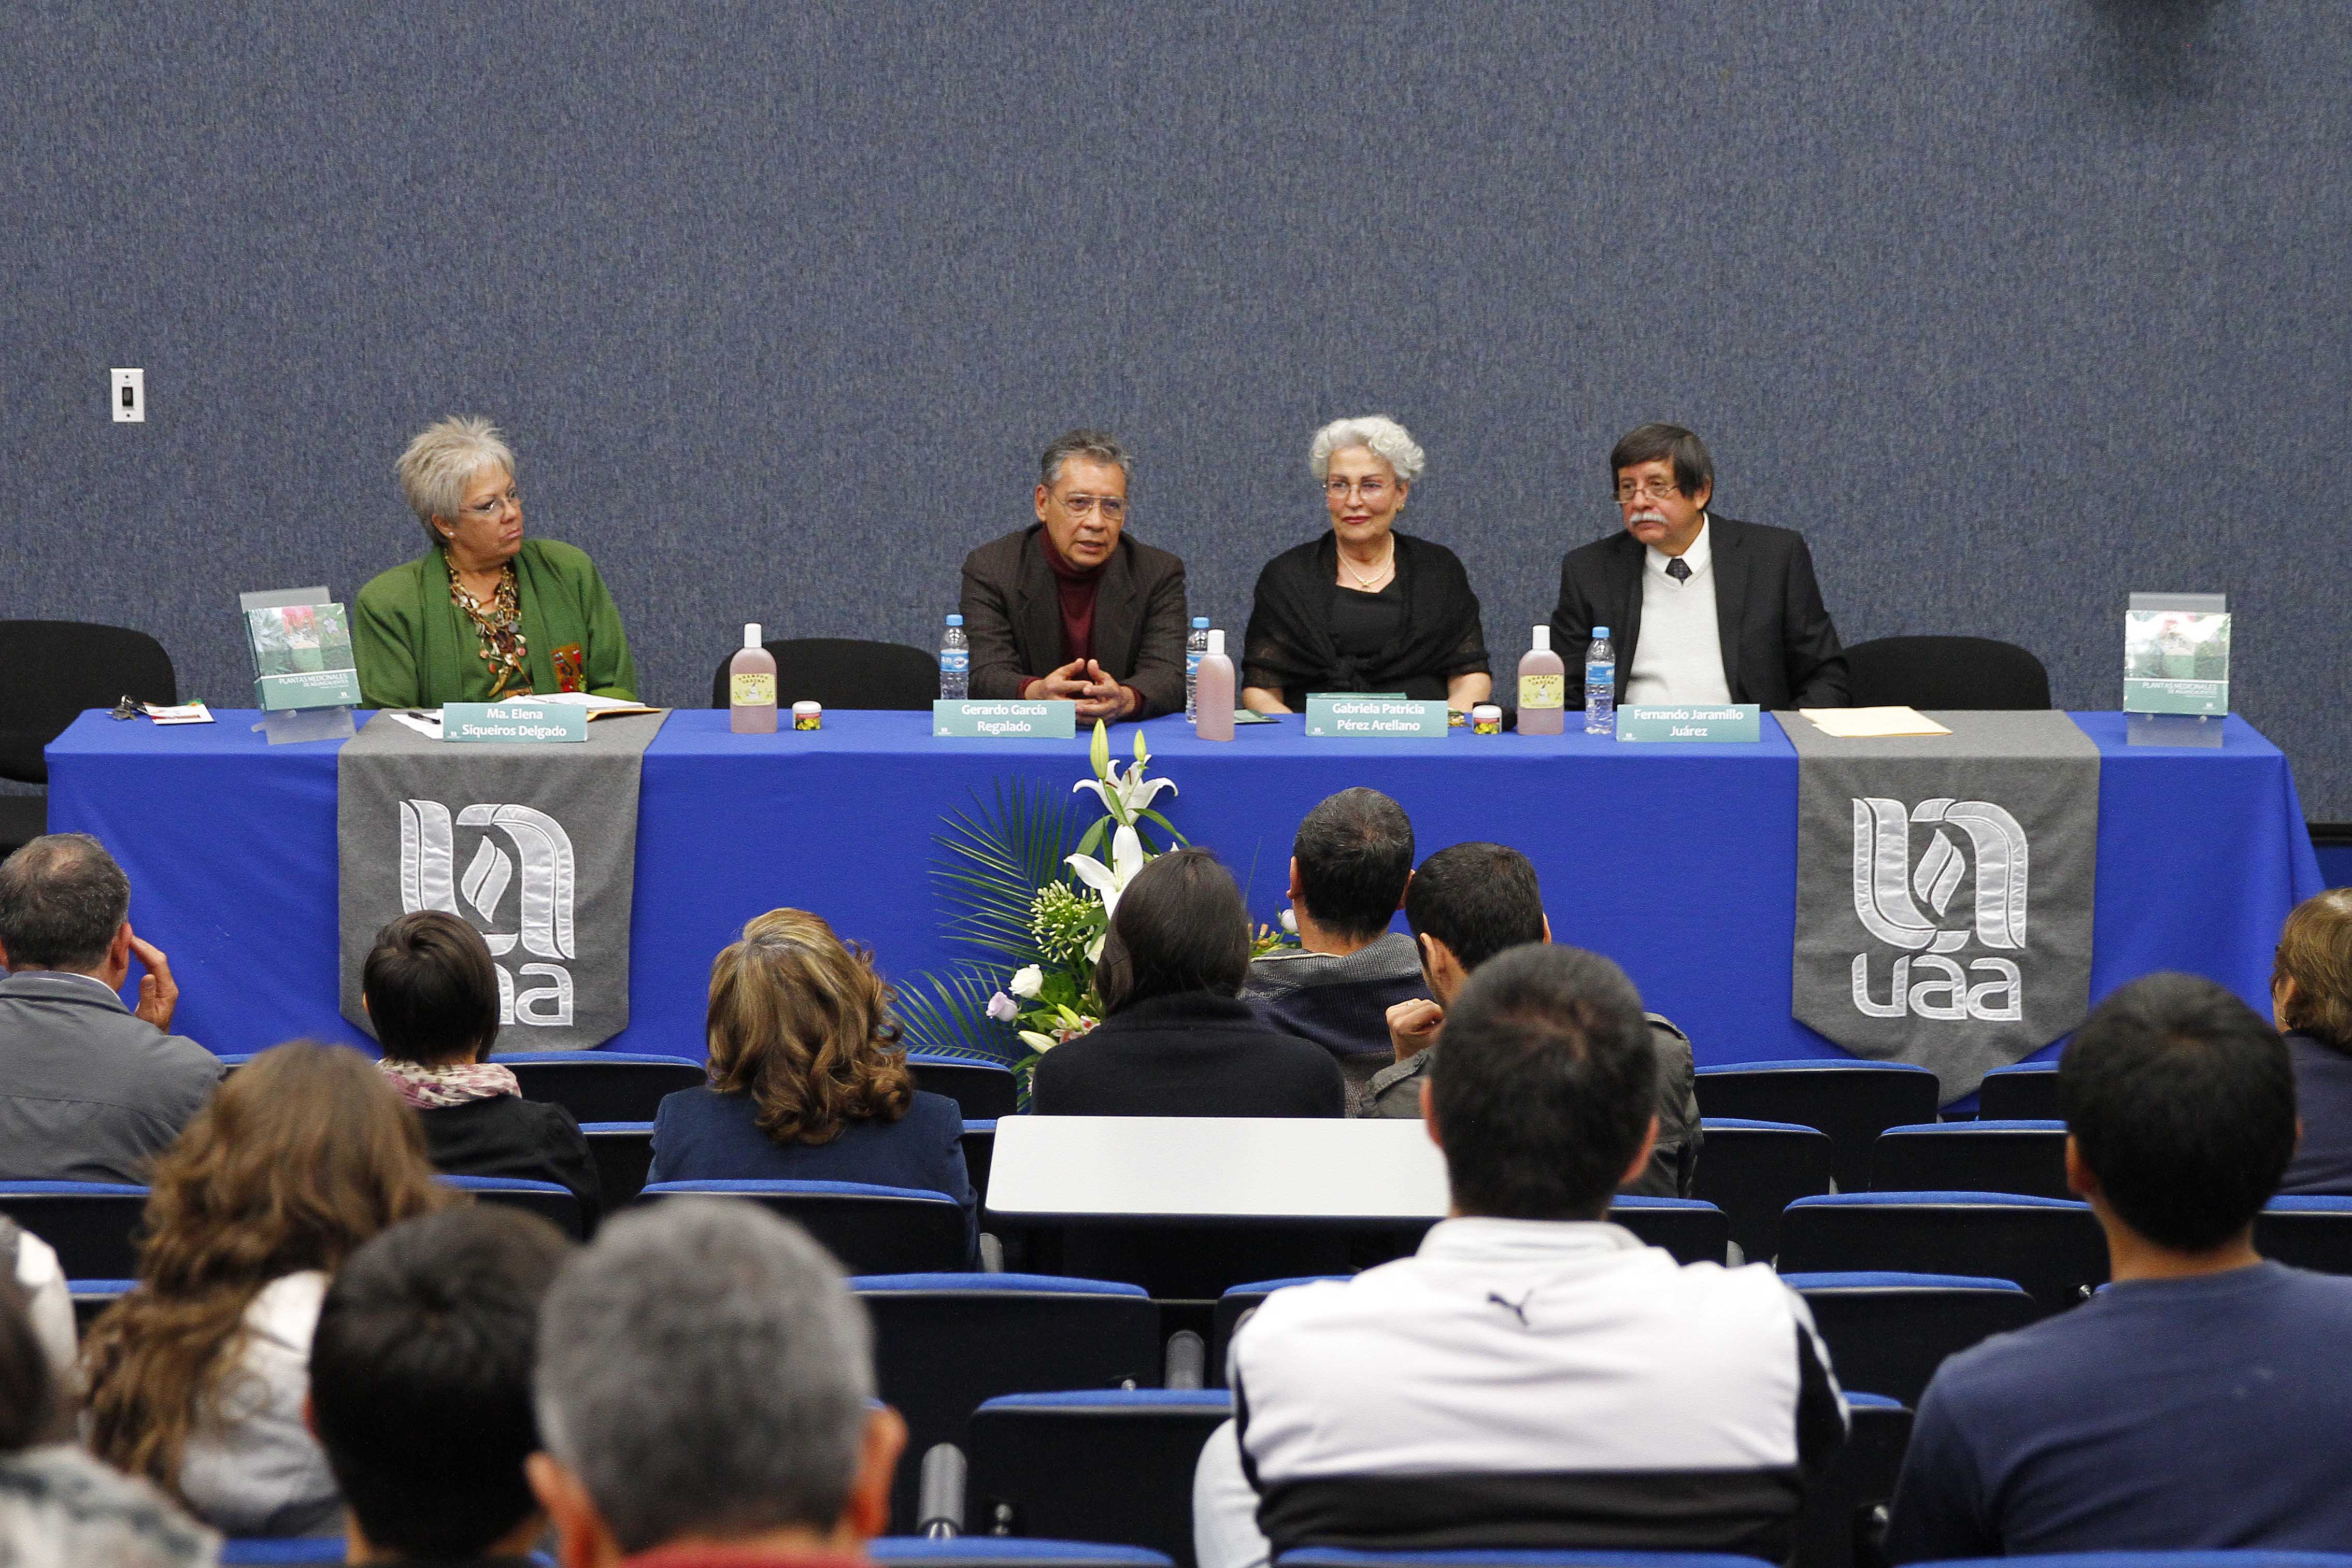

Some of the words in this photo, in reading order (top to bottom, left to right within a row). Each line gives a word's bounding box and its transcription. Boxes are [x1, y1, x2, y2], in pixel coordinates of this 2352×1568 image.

[278, 676, 308, 685] PLANTAS
[486, 708, 509, 719] Ma.
[511, 708, 544, 720] Elena
[961, 704, 1009, 715] Gerardo
[1010, 703, 1047, 715] García
[1332, 703, 1380, 715] Gabriela
[1381, 703, 1426, 715] Patricia
[1633, 708, 1689, 720] Fernando
[1690, 708, 1744, 720] Jaramillo
[977, 720, 1031, 735] Regalado
[1337, 719, 1369, 731] Pérez
[1371, 720, 1420, 731] Arellano
[1670, 725, 1708, 737] Juárez
[461, 723, 517, 739] Siqueiros
[518, 724, 567, 740] Delgado
[1851, 952, 2022, 1021] uaa
